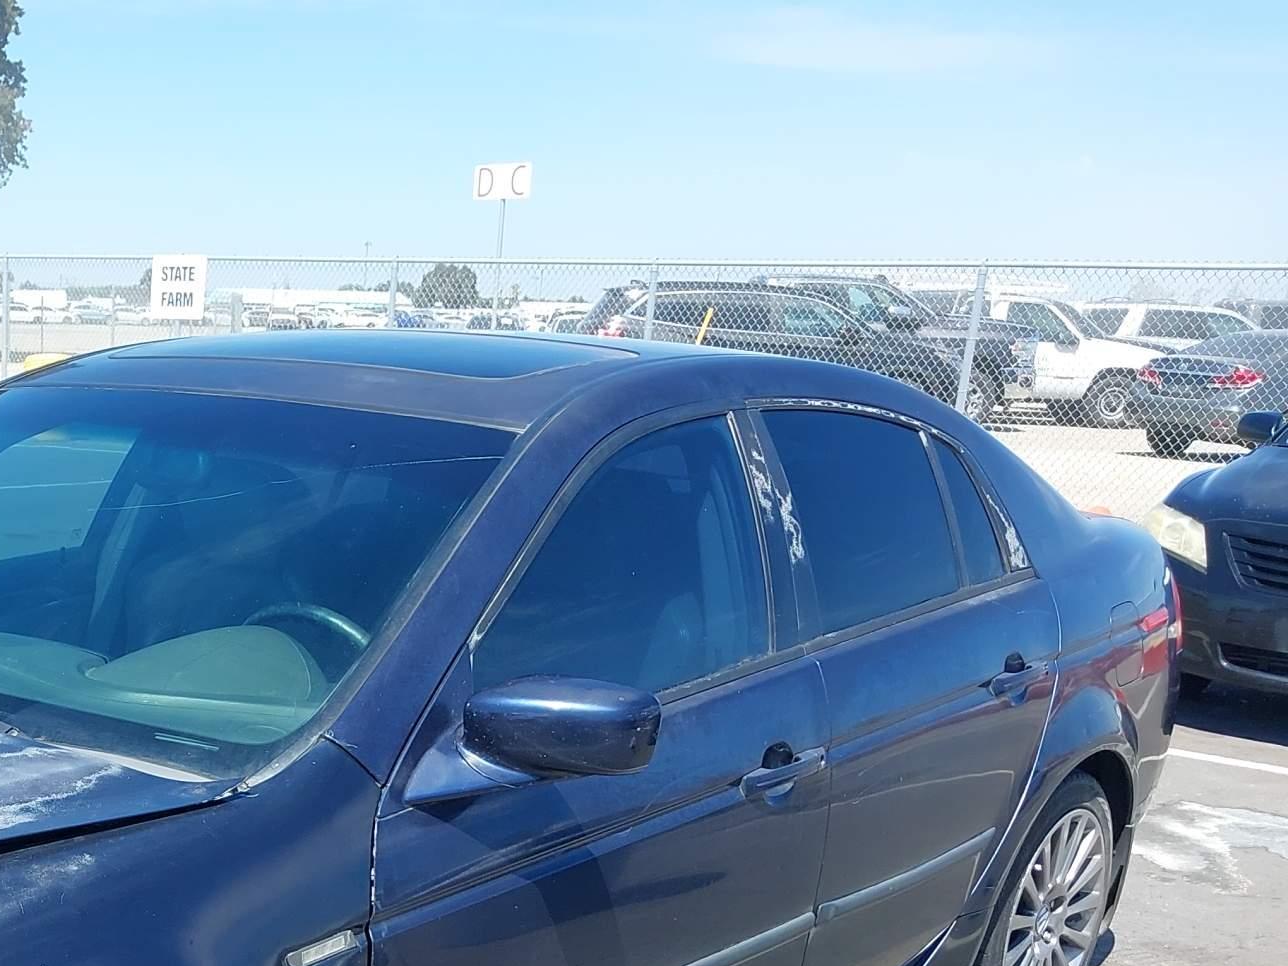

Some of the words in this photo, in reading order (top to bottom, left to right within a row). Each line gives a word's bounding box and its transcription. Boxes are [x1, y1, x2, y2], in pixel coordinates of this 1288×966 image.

[477, 167, 494, 198] D
[511, 164, 527, 196] C
[161, 266, 196, 282] STATE
[161, 291, 194, 307] FARM
